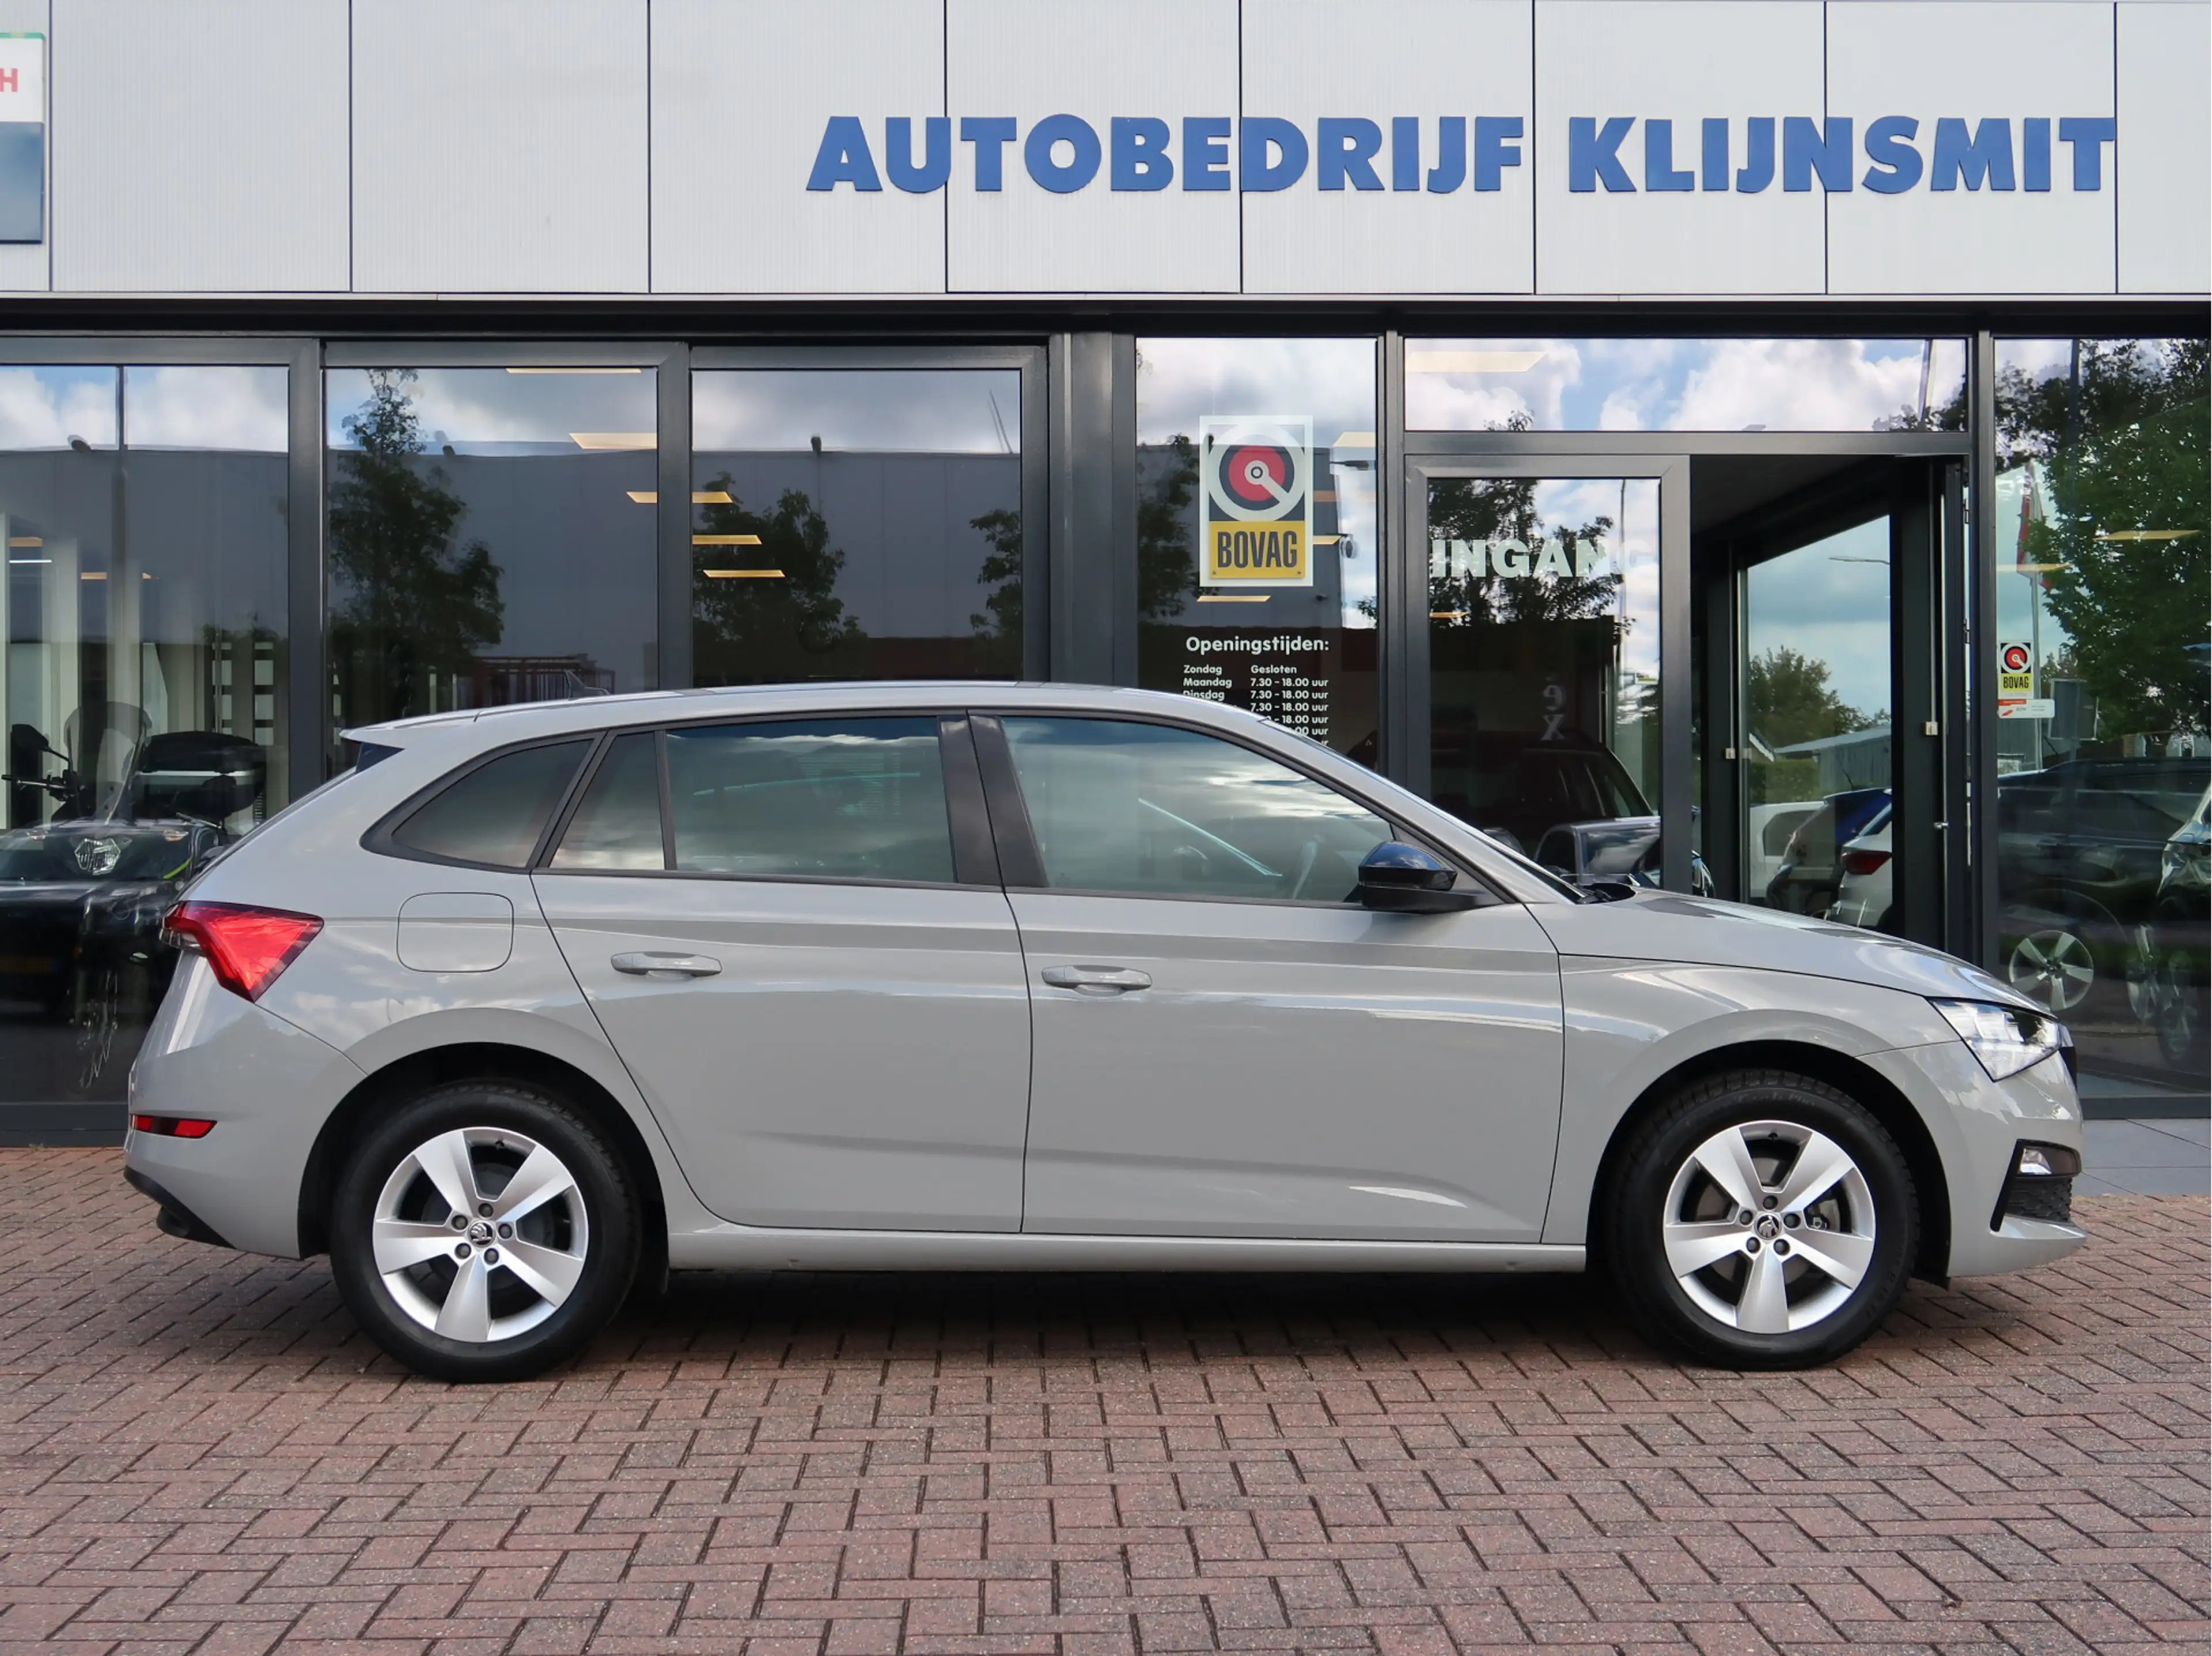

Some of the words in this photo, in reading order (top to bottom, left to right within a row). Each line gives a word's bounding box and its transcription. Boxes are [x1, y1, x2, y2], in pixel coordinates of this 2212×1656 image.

[808, 114, 1523, 194] AUTOBEDRIJF
[1569, 116, 2116, 194] KLIJNSMIT
[1217, 531, 1297, 568] BOVAG
[1185, 636, 1330, 656] Openingstijden:
[1183, 664, 1222, 676] Zondag
[1251, 664, 1297, 674] Gesloten
[1183, 678, 1232, 689] Maandag
[1250, 678, 1272, 686] 7.30
[1282, 678, 1309, 686] 18.00
[2003, 676, 2029, 689] BOVAG
[1250, 690, 1272, 699] 7.30
[1282, 690, 1309, 699] 18.00
[1250, 703, 1272, 711] 7.30
[1282, 703, 1309, 711] 18.00
[1282, 715, 1309, 724] 18.00
